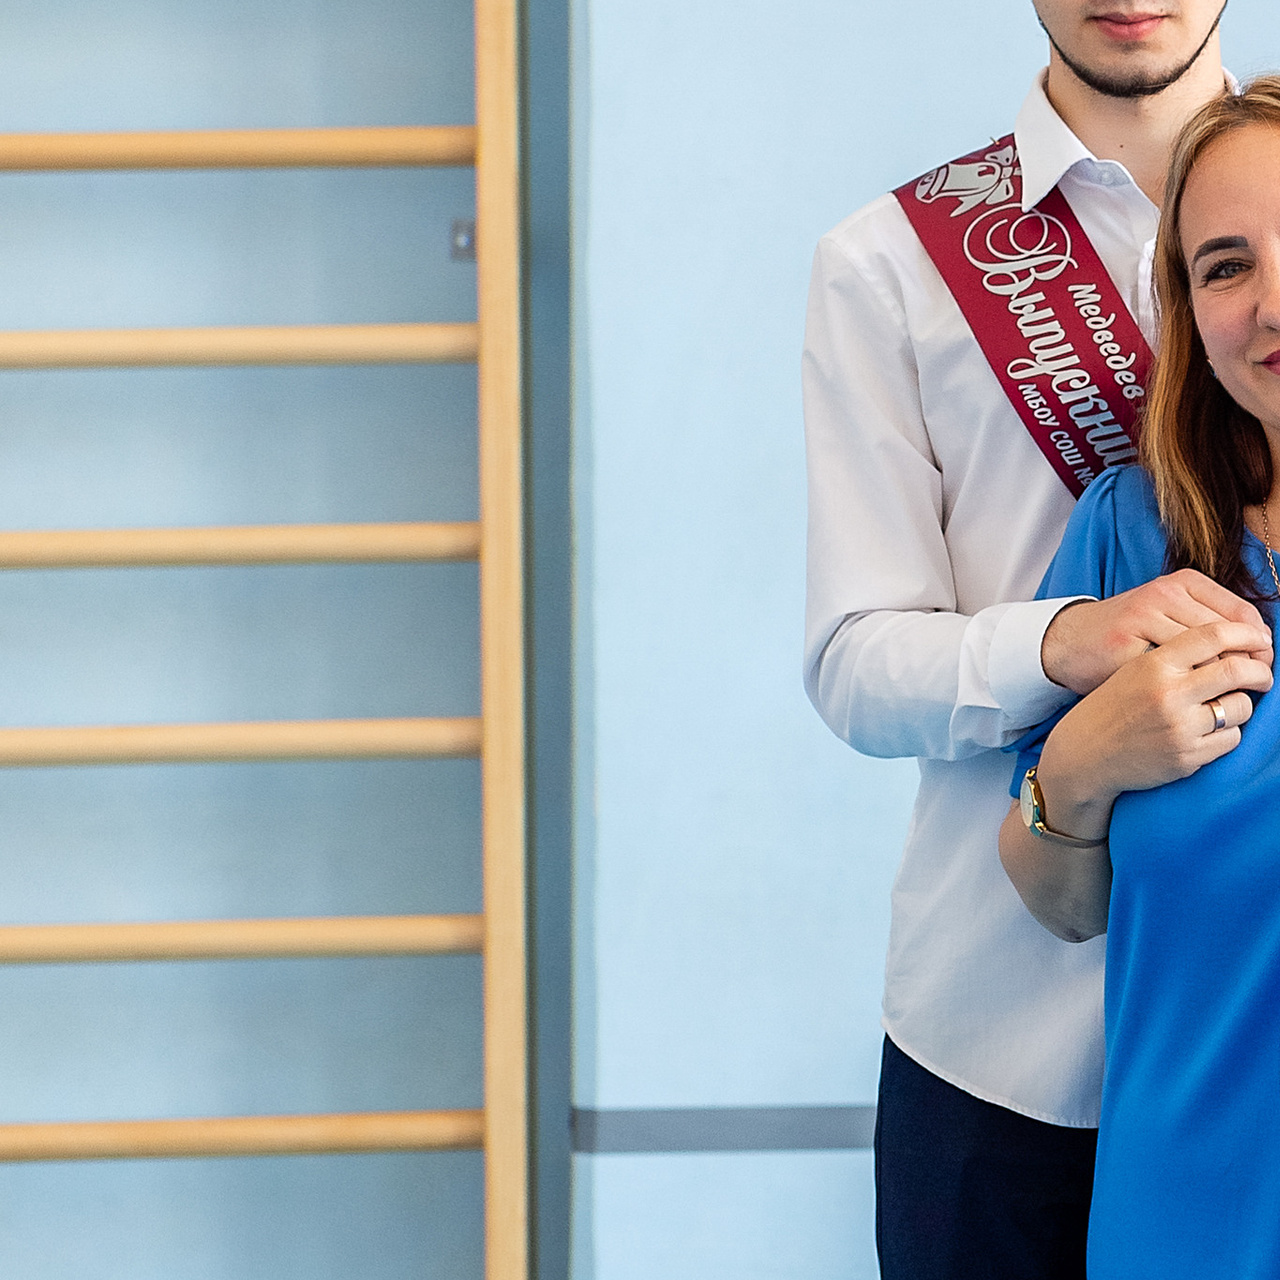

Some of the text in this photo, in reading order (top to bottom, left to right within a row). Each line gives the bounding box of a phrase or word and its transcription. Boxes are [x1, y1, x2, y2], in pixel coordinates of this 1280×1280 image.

[963, 202, 1139, 467] Выпускни
[1068, 283, 1144, 400] Медведев
[1018, 384, 1060, 427] МБОУ
[1050, 430, 1085, 466] СОШ
